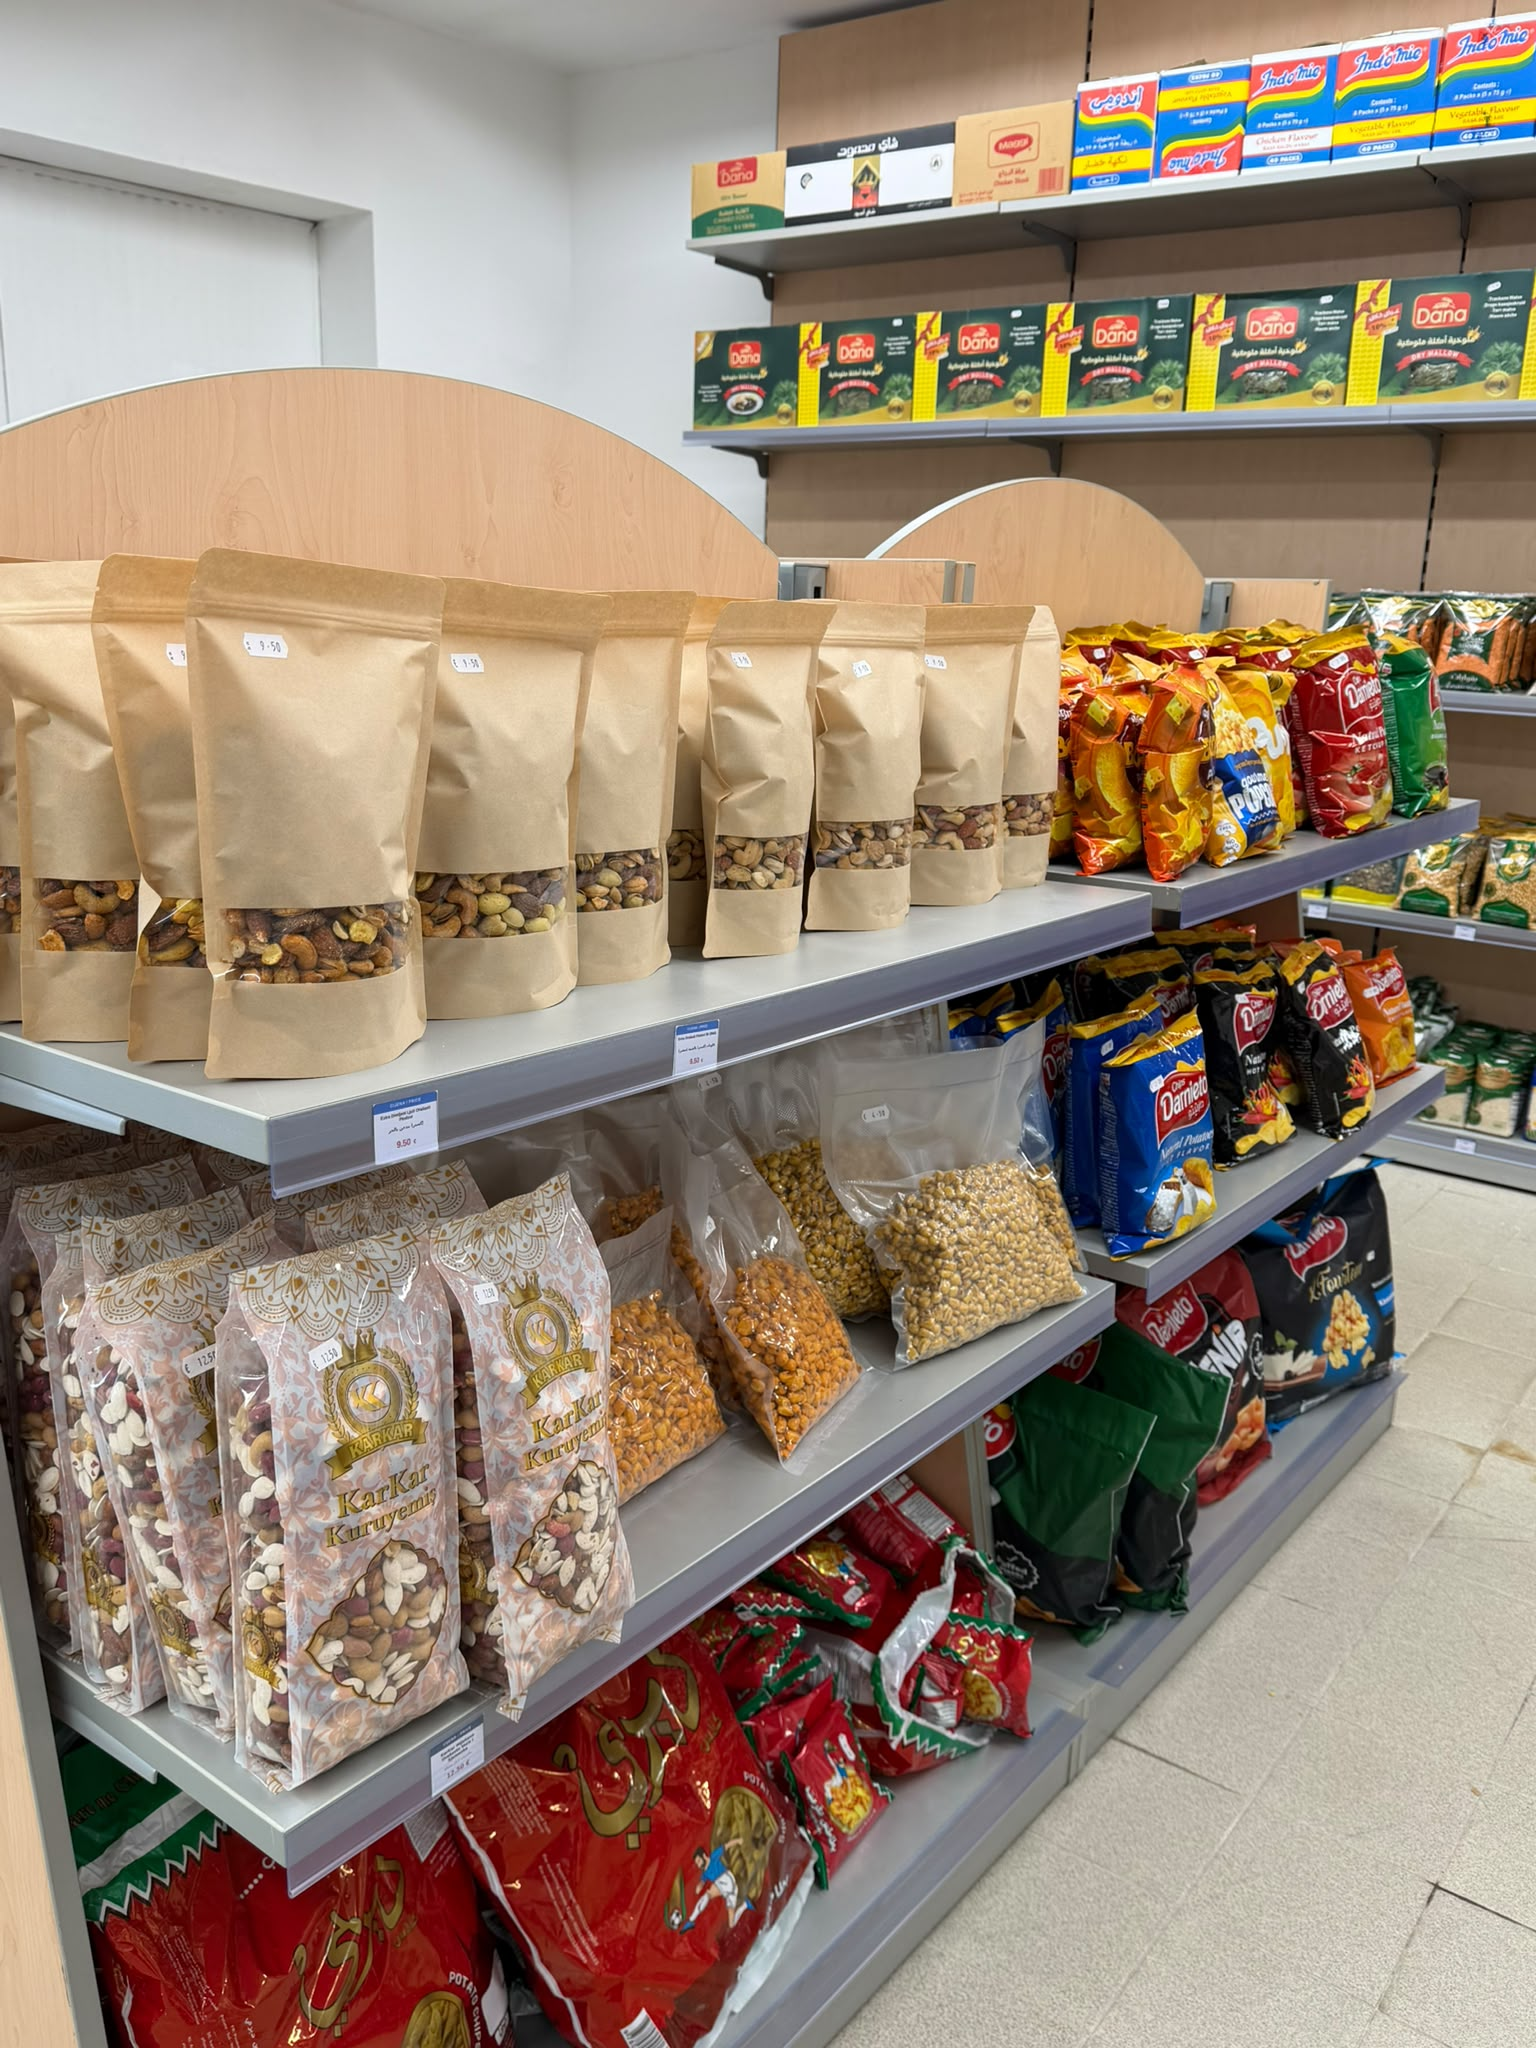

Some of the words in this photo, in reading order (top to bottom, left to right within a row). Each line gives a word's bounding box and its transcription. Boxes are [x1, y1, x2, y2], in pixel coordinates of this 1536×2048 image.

[1450, 108, 1486, 119] Vegetable
[1487, 105, 1520, 114] Flavour
[1349, 122, 1385, 134] Vegetable
[1387, 119, 1416, 128] Flavour
[878, 136, 899, 152] شاي
[1256, 135, 1286, 146] Chicken
[1288, 133, 1318, 142] Flavour
[837, 142, 876, 158] محمود
[720, 170, 754, 185] Dana
[1416, 308, 1467, 325] Dana
[1095, 328, 1137, 345] Dana
[1250, 320, 1295, 337] Dana
[961, 336, 999, 351] Dana
[731, 352, 760, 365] Dana
[840, 346, 874, 361] Dana
[1427, 349, 1459, 359] MALLOW
[396, 1138, 411, 1148] 9.50
[532, 1353, 583, 1388] KARKAR
[531, 1390, 602, 1444] KarKar
[349, 1423, 413, 1459] KARKAR
[337, 1463, 430, 1518] KarKar
[325, 1487, 437, 1547] Kuruyemiş
[448, 1970, 479, 2006] POTATO
